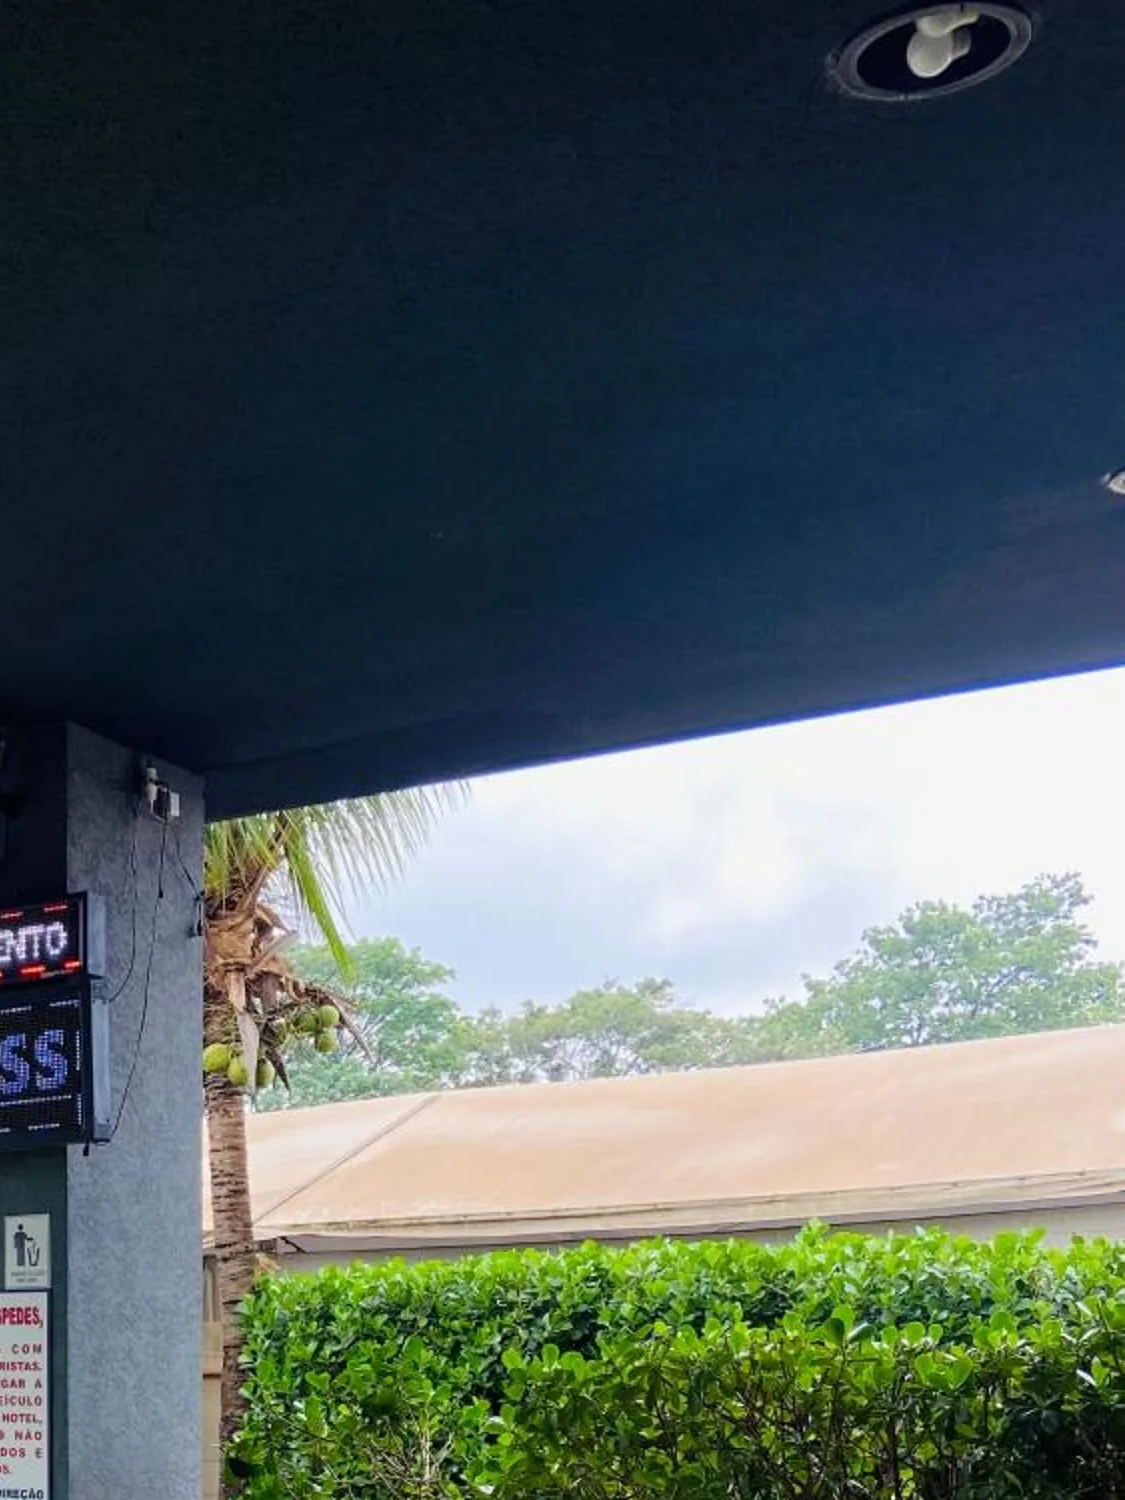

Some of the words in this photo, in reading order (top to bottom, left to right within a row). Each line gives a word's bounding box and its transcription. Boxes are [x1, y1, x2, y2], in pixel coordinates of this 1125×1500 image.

[12, 1343, 42, 1355] COM
[34, 1379, 42, 1389] A
[14, 1430, 42, 1441] NÃO
[35, 1448, 43, 1459] E
